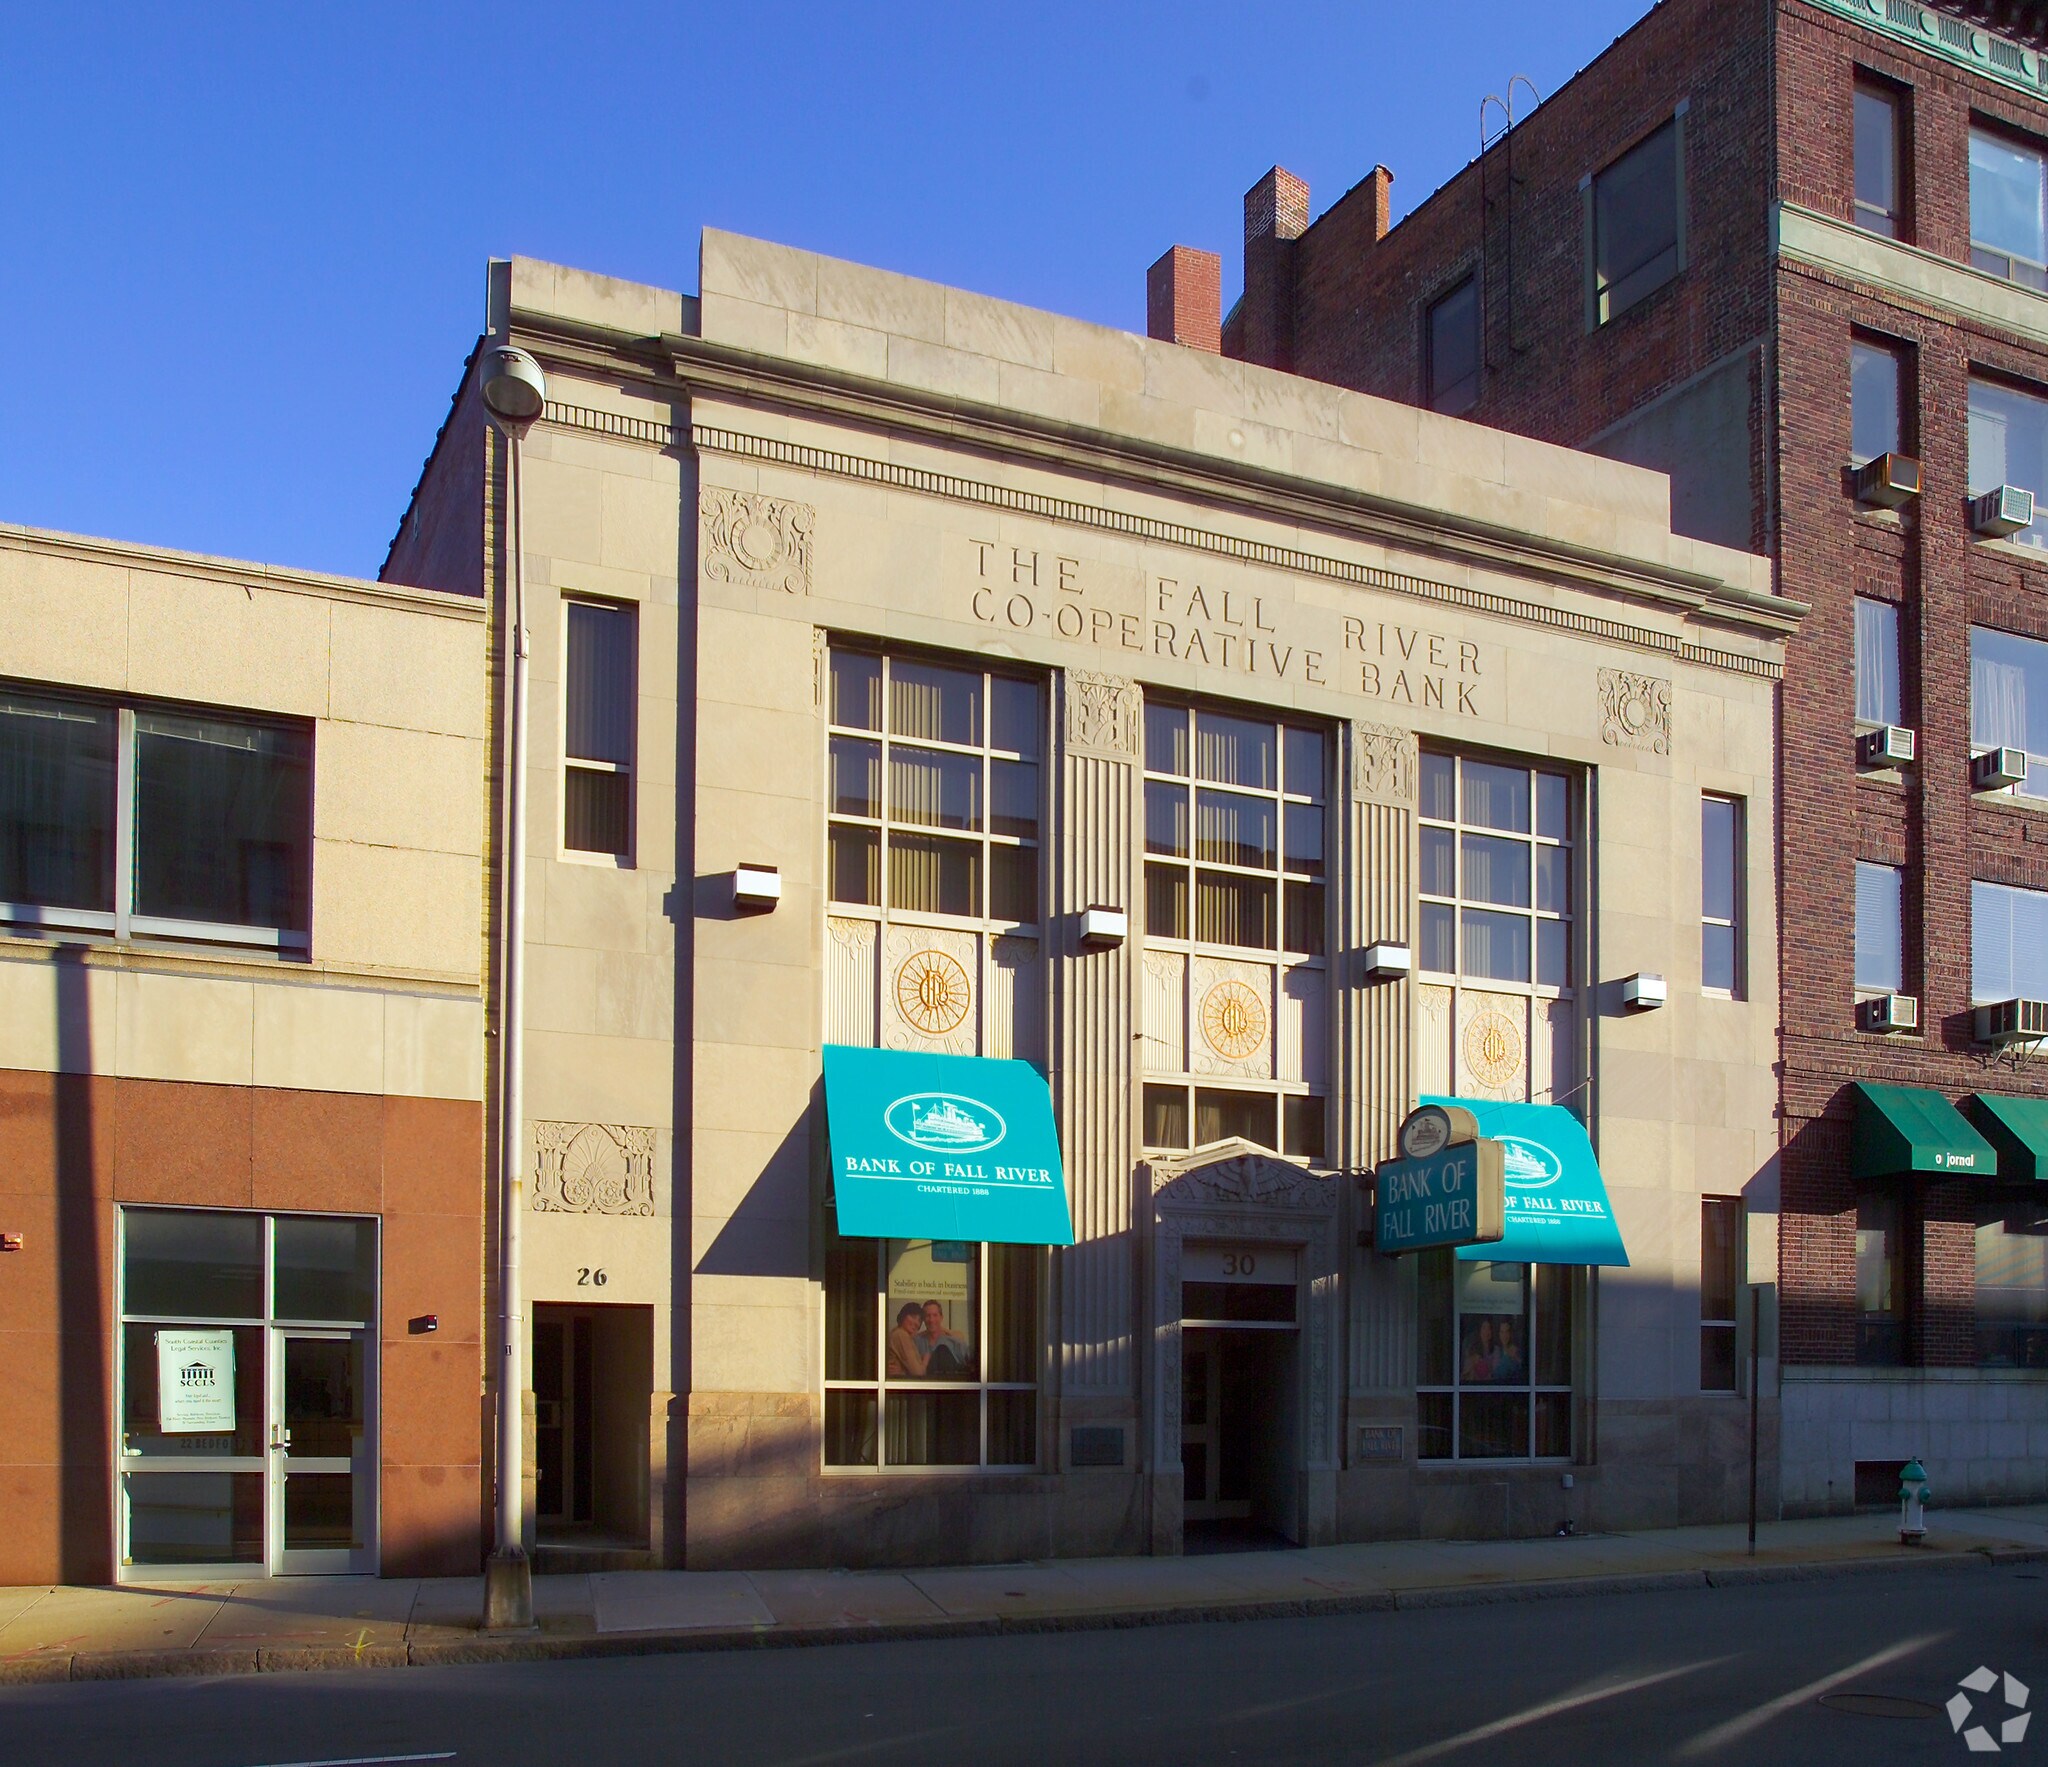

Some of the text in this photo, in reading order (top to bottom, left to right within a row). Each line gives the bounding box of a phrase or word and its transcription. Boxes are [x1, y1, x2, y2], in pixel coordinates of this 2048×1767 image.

[969, 538, 1481, 676] THE FALL RIVER
[971, 587, 1479, 716] CO-OPERATIVE BANK
[845, 1156, 1052, 1183] BANK OF FALL RIVER
[1935, 1152, 1974, 1167] o jornal
[917, 1184, 989, 1196] CHARTERED 1888
[1388, 1160, 1467, 1204] BANK OF
[1523, 1197, 1556, 1210] FALL
[1560, 1199, 1604, 1213] RIVER
[1383, 1199, 1470, 1240] FALL RIVER
[1507, 1216, 1546, 1225] CHARTERED
[1223, 1254, 1255, 1276] 30
[577, 1267, 608, 1286] 26
[180, 1379, 215, 1387] SCCLS
